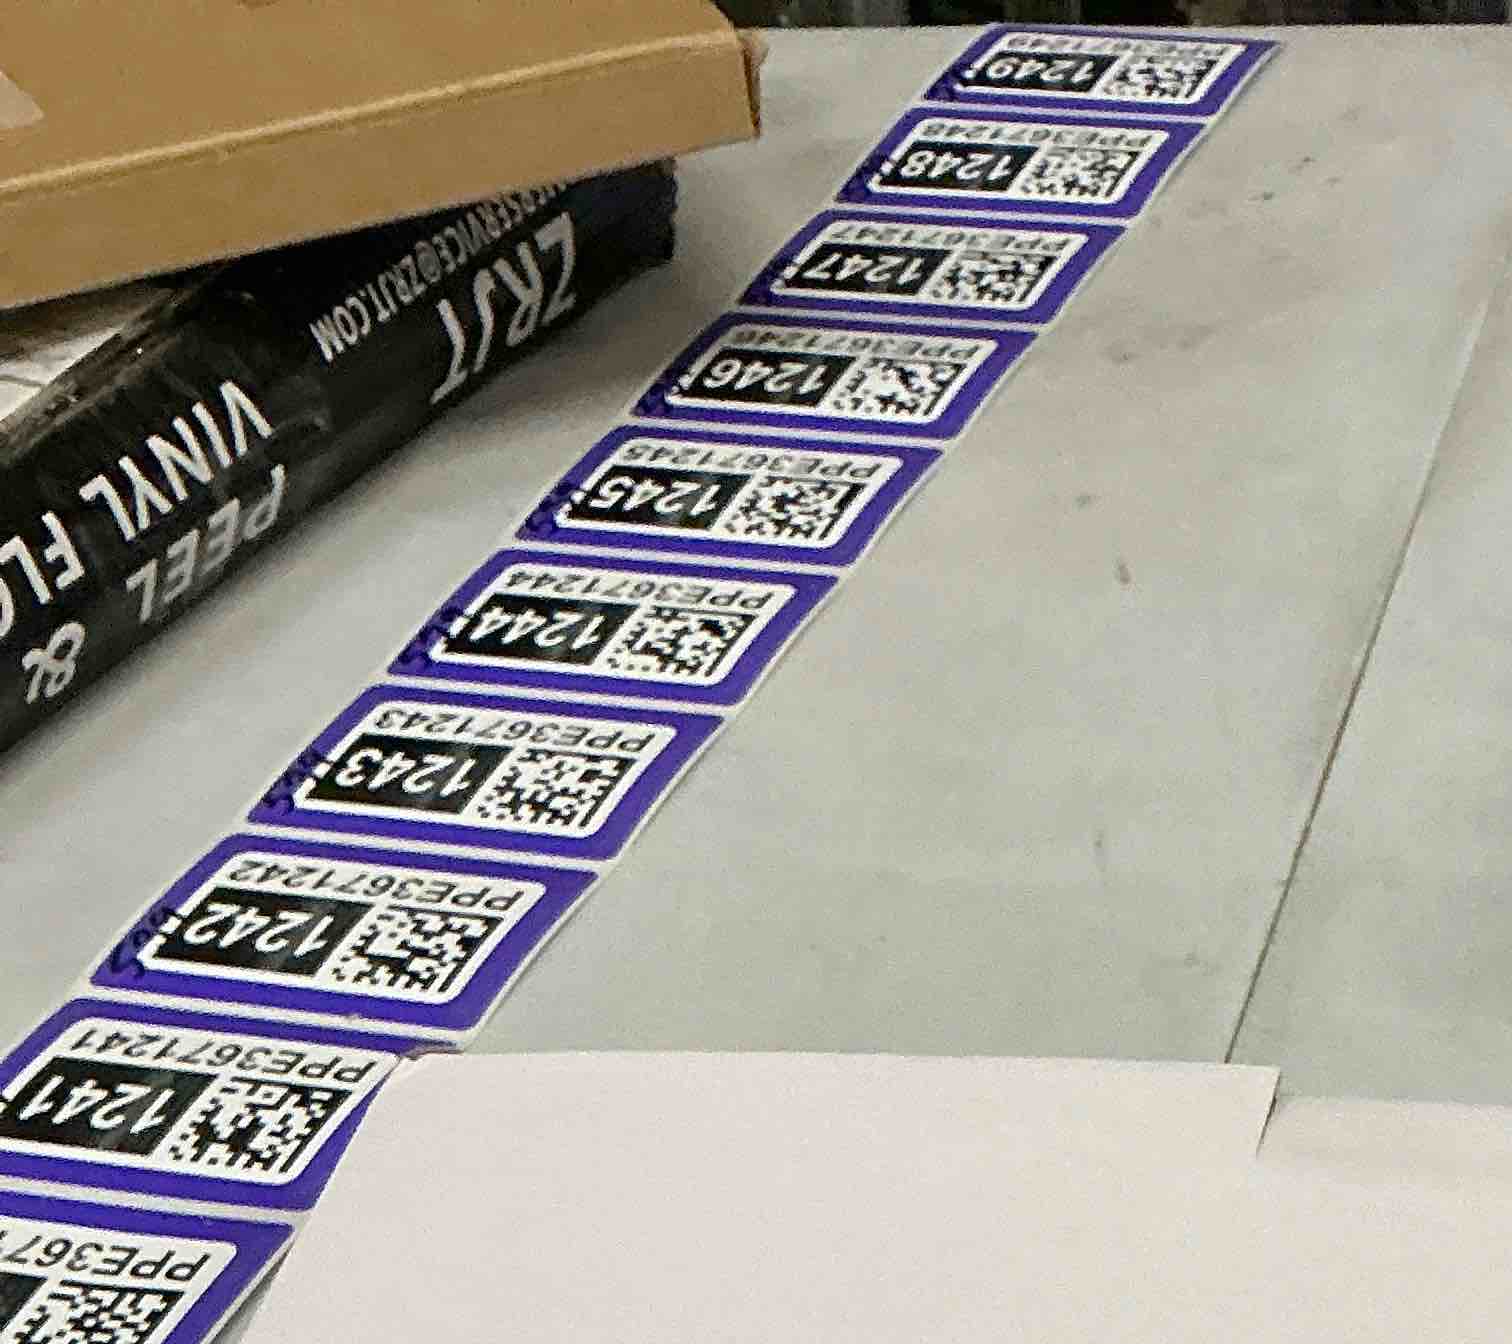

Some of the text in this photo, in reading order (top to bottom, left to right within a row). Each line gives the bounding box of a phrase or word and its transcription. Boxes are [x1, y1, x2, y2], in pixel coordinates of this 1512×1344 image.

[986, 57, 1096, 83] 1249
[902, 151, 1015, 180] 1248
[801, 252, 925, 284] 1247
[430, 211, 577, 405] ZRJT
[703, 359, 828, 394] 1246
[79, 379, 276, 542] VINYL
[623, 443, 882, 480] PPE3671245
[588, 474, 719, 517] 1245
[22, 463, 286, 705] PEEL &
[506, 569, 775, 610] PPE3671244
[471, 606, 601, 651] 1244
[375, 708, 651, 754] PPE3671243
[335, 747, 478, 800] 1243
[227, 859, 525, 913] PPE3671242
[183, 902, 331, 957] 1242
[71, 1029, 376, 1084] PPE3671241
[17, 1074, 175, 1135] 1241
[0, 1230, 211, 1282] PPE367
